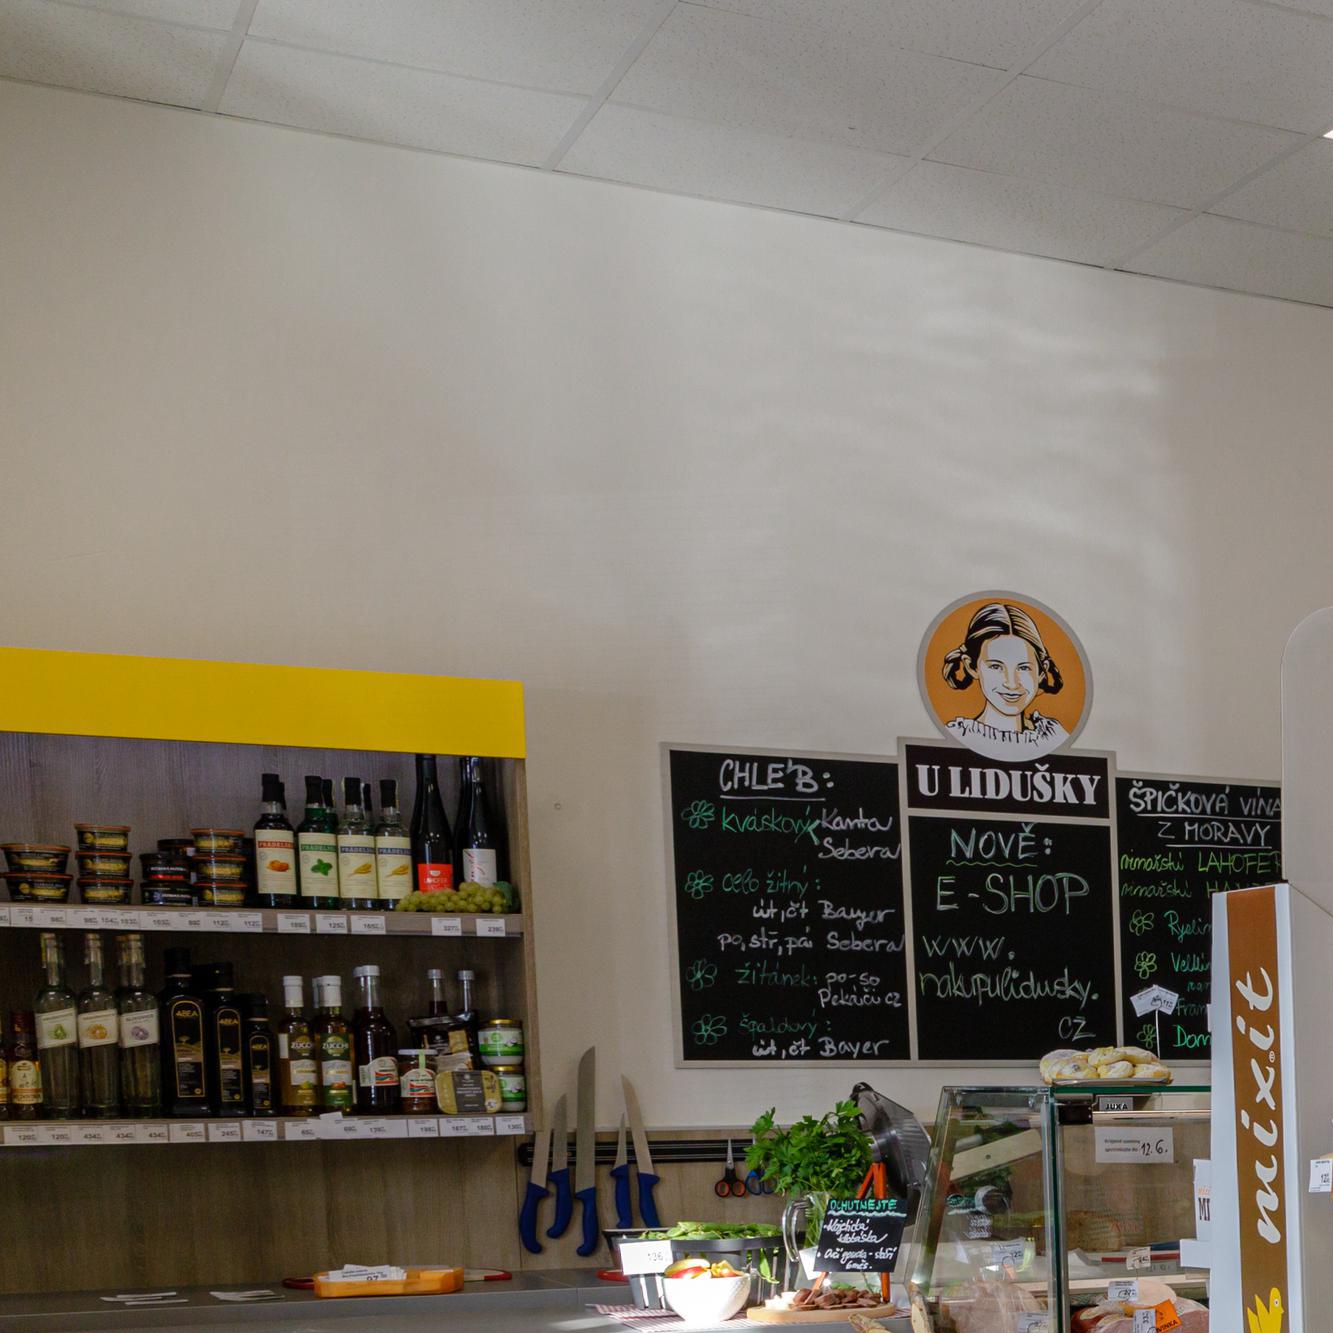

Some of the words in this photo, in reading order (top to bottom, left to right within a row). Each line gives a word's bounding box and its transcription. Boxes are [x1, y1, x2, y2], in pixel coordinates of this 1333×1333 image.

[915, 764, 940, 797] U
[948, 763, 1101, 805] LIDUŠKY
[1129, 780, 1230, 816] ŠPIČKOVÁ
[1239, 788, 1282, 818] VÍNA
[1157, 821, 1176, 840] Z
[1184, 821, 1271, 848] MORAVY
[818, 836, 901, 861] Sebera
[827, 930, 906, 953] Sebera
[818, 1036, 891, 1058] Bayer
[1235, 966, 1281, 1245] mixit
[830, 1198, 898, 1211] OCHUTNEJTE
[1155, 1318, 1179, 1333] VINKA
